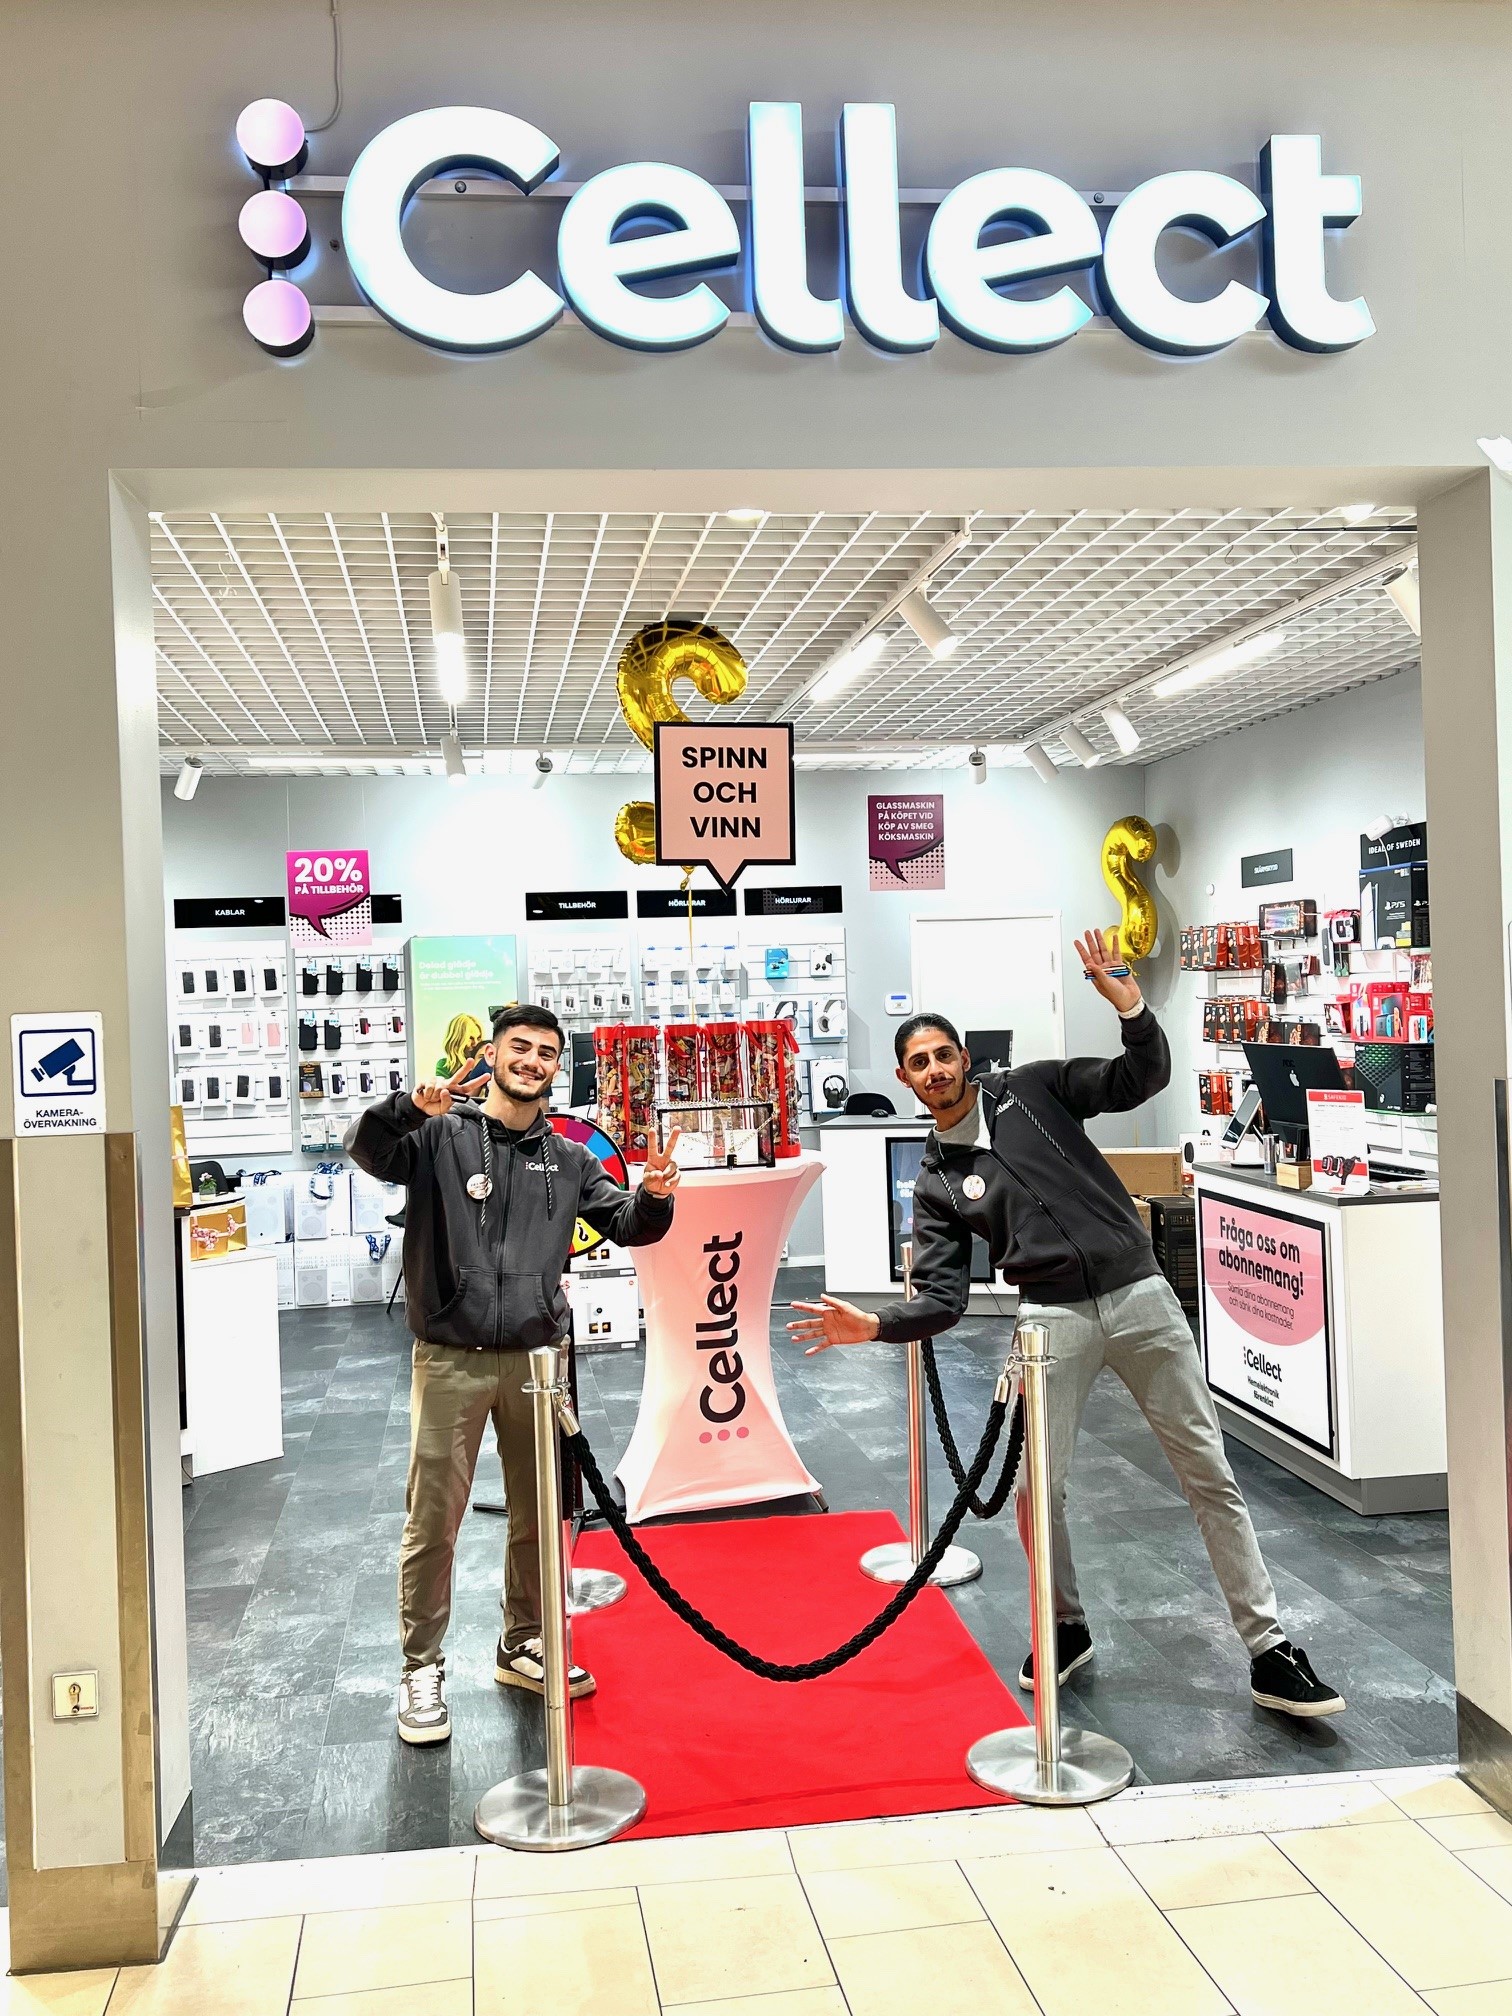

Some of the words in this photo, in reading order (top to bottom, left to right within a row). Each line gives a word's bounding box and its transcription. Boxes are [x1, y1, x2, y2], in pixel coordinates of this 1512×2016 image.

[341, 100, 1377, 355] Cellect
[681, 746, 767, 769] SPINN
[693, 781, 757, 803] OCH
[876, 802, 935, 810] GLASSMASKIN
[878, 811, 890, 820] PÅ
[891, 811, 917, 820] KÖPET
[689, 817, 761, 838] VINN
[878, 821, 896, 831] KÖP
[910, 822, 934, 830] SMEG
[878, 832, 934, 841] KÖKSMASKIN
[1368, 845, 1387, 855] IDEAL
[1386, 843, 1395, 851] OF
[1395, 838, 1421, 850] SWEDEN
[294, 857, 363, 883] 20%
[294, 884, 310, 895] PÅ
[310, 883, 364, 895] TILLBEHÖR
[558, 901, 597, 909] TILLBEHÖR
[774, 896, 812, 904] HÖRLURAR
[36, 1108, 84, 1118] KAMERA-
[23, 1118, 97, 1129] ÖVERVAKNING
[528, 1162, 560, 1172] Cellct
[1219, 1216, 1254, 1251] Fråga
[1256, 1234, 1277, 1256] oss
[1280, 1241, 1301, 1264] om
[1218, 1246, 1304, 1300] abonnemang!
[1227, 1281, 1244, 1297] Samla
[1244, 1289, 1256, 1302] dina
[1256, 1294, 1295, 1320] abonnemang
[1229, 1296, 1239, 1306] och
[1239, 1300, 1251, 1312] sänk
[1252, 1305, 1264, 1318] dina
[695, 1230, 746, 1424] Cellect
[1246, 1348, 1283, 1383] Cellect
